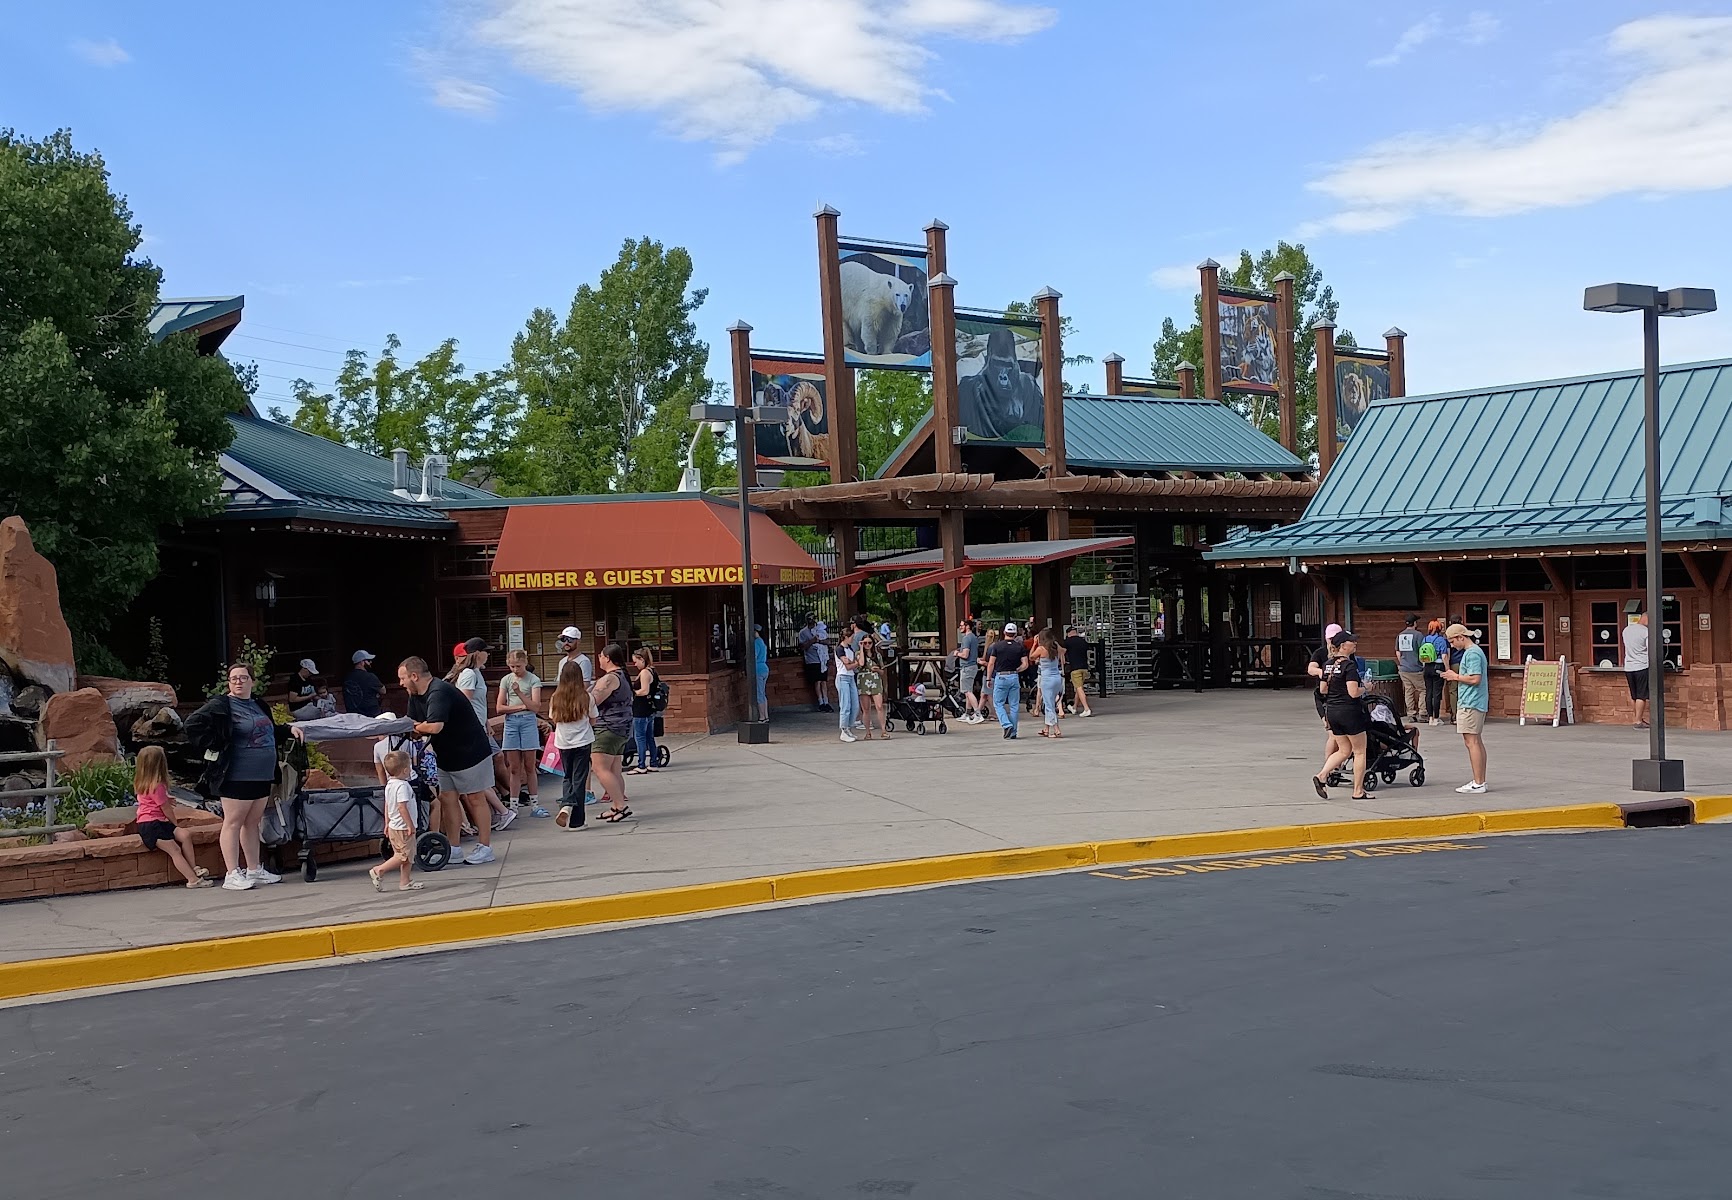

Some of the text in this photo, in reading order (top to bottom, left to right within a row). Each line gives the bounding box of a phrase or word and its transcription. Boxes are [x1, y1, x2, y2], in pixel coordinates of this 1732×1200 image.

[500, 572, 578, 589] MEMBER
[584, 571, 597, 586] &
[603, 569, 665, 586] GUEST
[1527, 691, 1554, 702] HERE
